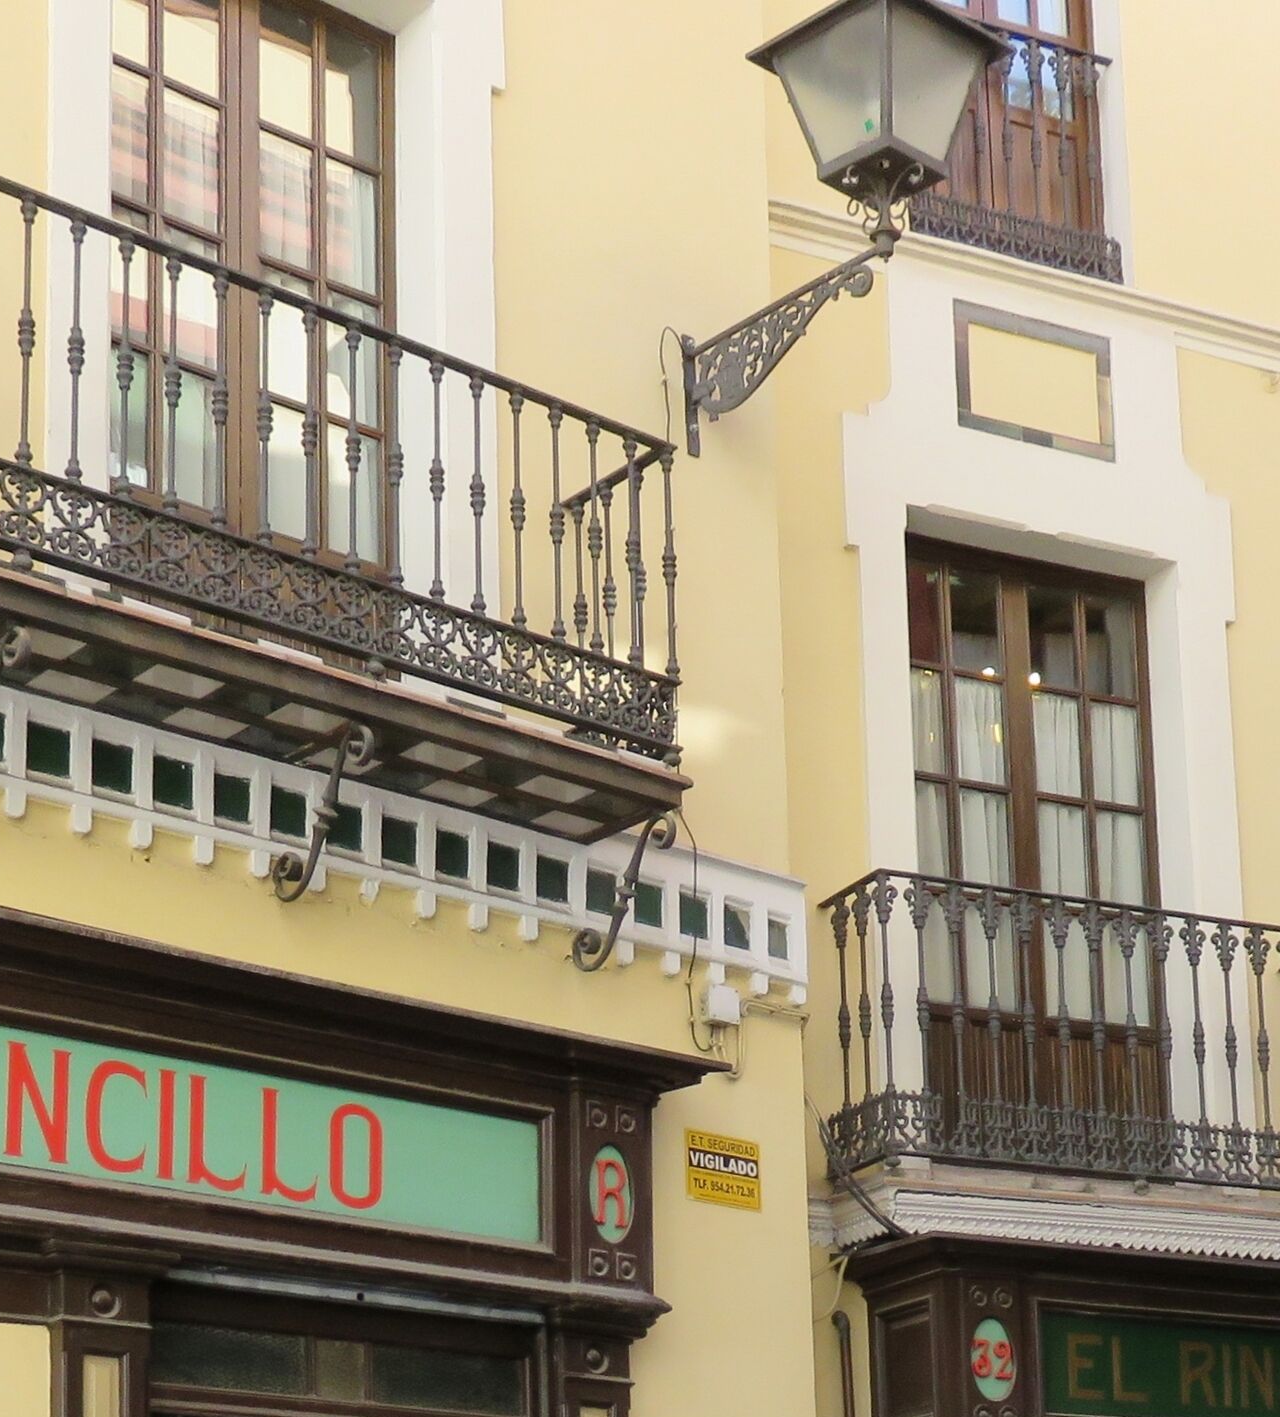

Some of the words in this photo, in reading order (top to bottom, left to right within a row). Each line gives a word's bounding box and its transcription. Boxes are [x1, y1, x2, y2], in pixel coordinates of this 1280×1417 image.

[690, 1151, 758, 1178] VIGILADO
[707, 1138, 755, 1158] SEGURIDAD
[593, 1160, 629, 1228] R
[1066, 1333, 1149, 1403] EL
